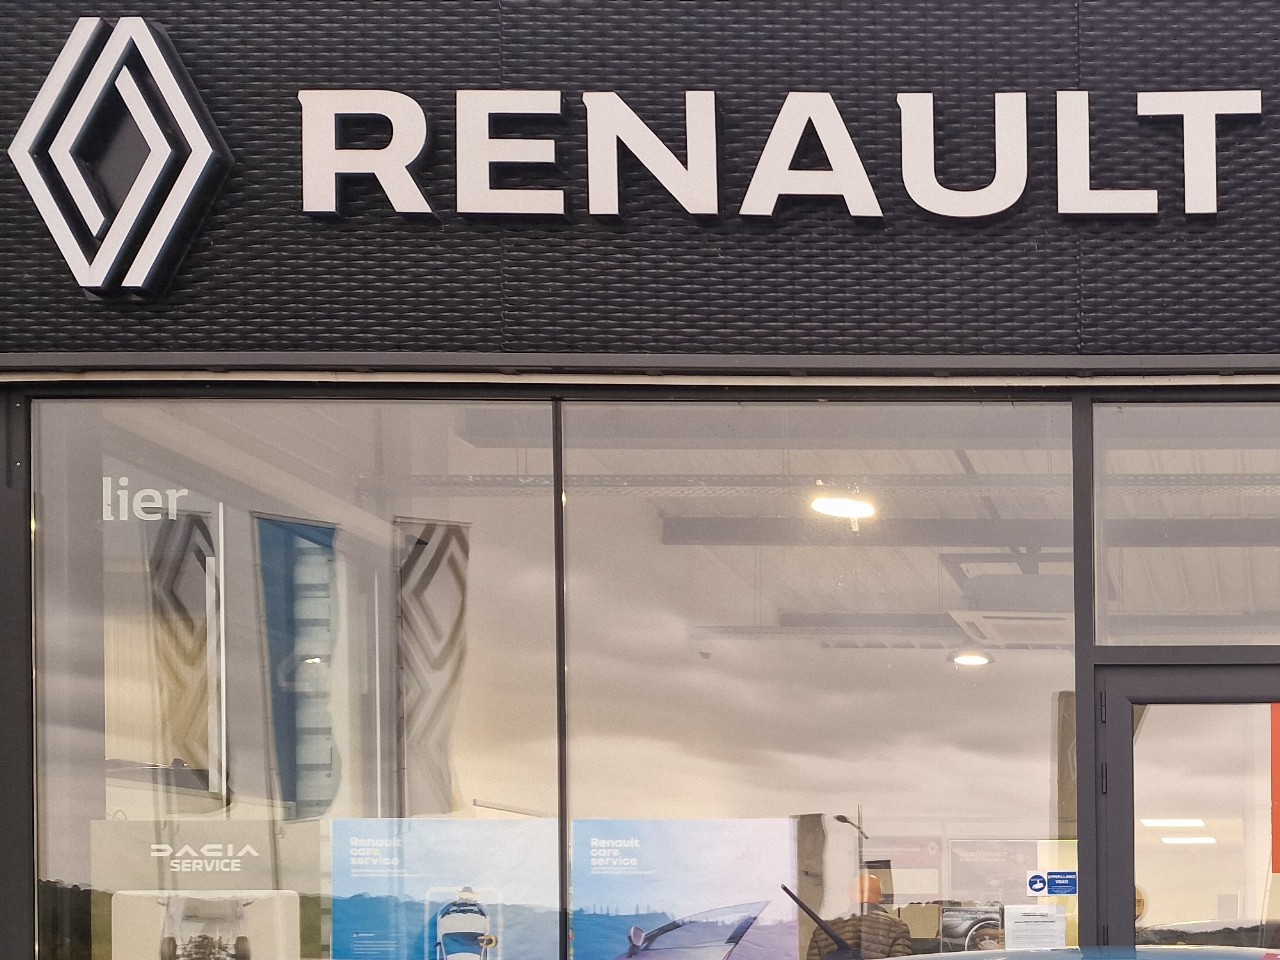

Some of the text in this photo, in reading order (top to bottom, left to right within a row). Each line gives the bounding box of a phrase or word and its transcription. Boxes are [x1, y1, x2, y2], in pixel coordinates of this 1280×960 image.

[299, 90, 1262, 217] RENAULT
[590, 837, 640, 847] Renault
[150, 844, 260, 857] DACIA
[590, 848, 619, 857] care
[170, 859, 241, 872] SERVICE
[350, 857, 399, 865] service
[590, 856, 637, 866] service
